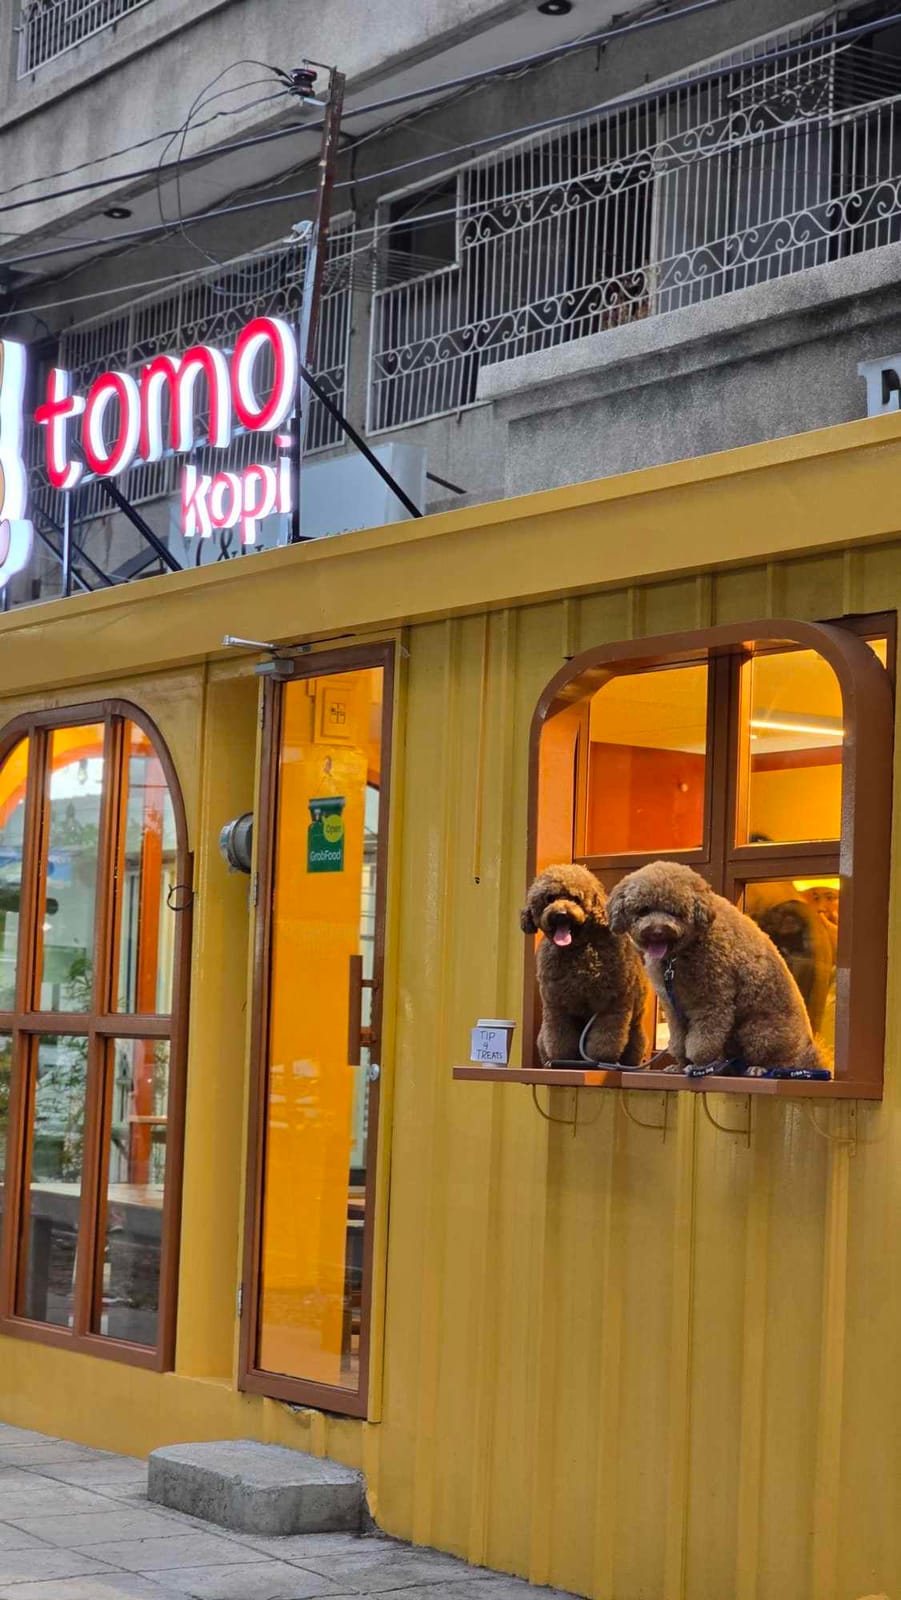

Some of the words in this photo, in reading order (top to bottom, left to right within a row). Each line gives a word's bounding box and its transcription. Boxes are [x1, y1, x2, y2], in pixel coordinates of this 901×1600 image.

[34, 316, 297, 489] tomo
[181, 434, 293, 545] kopi
[325, 825, 341, 834] Open
[310, 849, 342, 862] GrabFood
[480, 1030, 496, 1041] TIP
[482, 1041, 489, 1050] 4
[476, 1049, 503, 1060] TREATS
